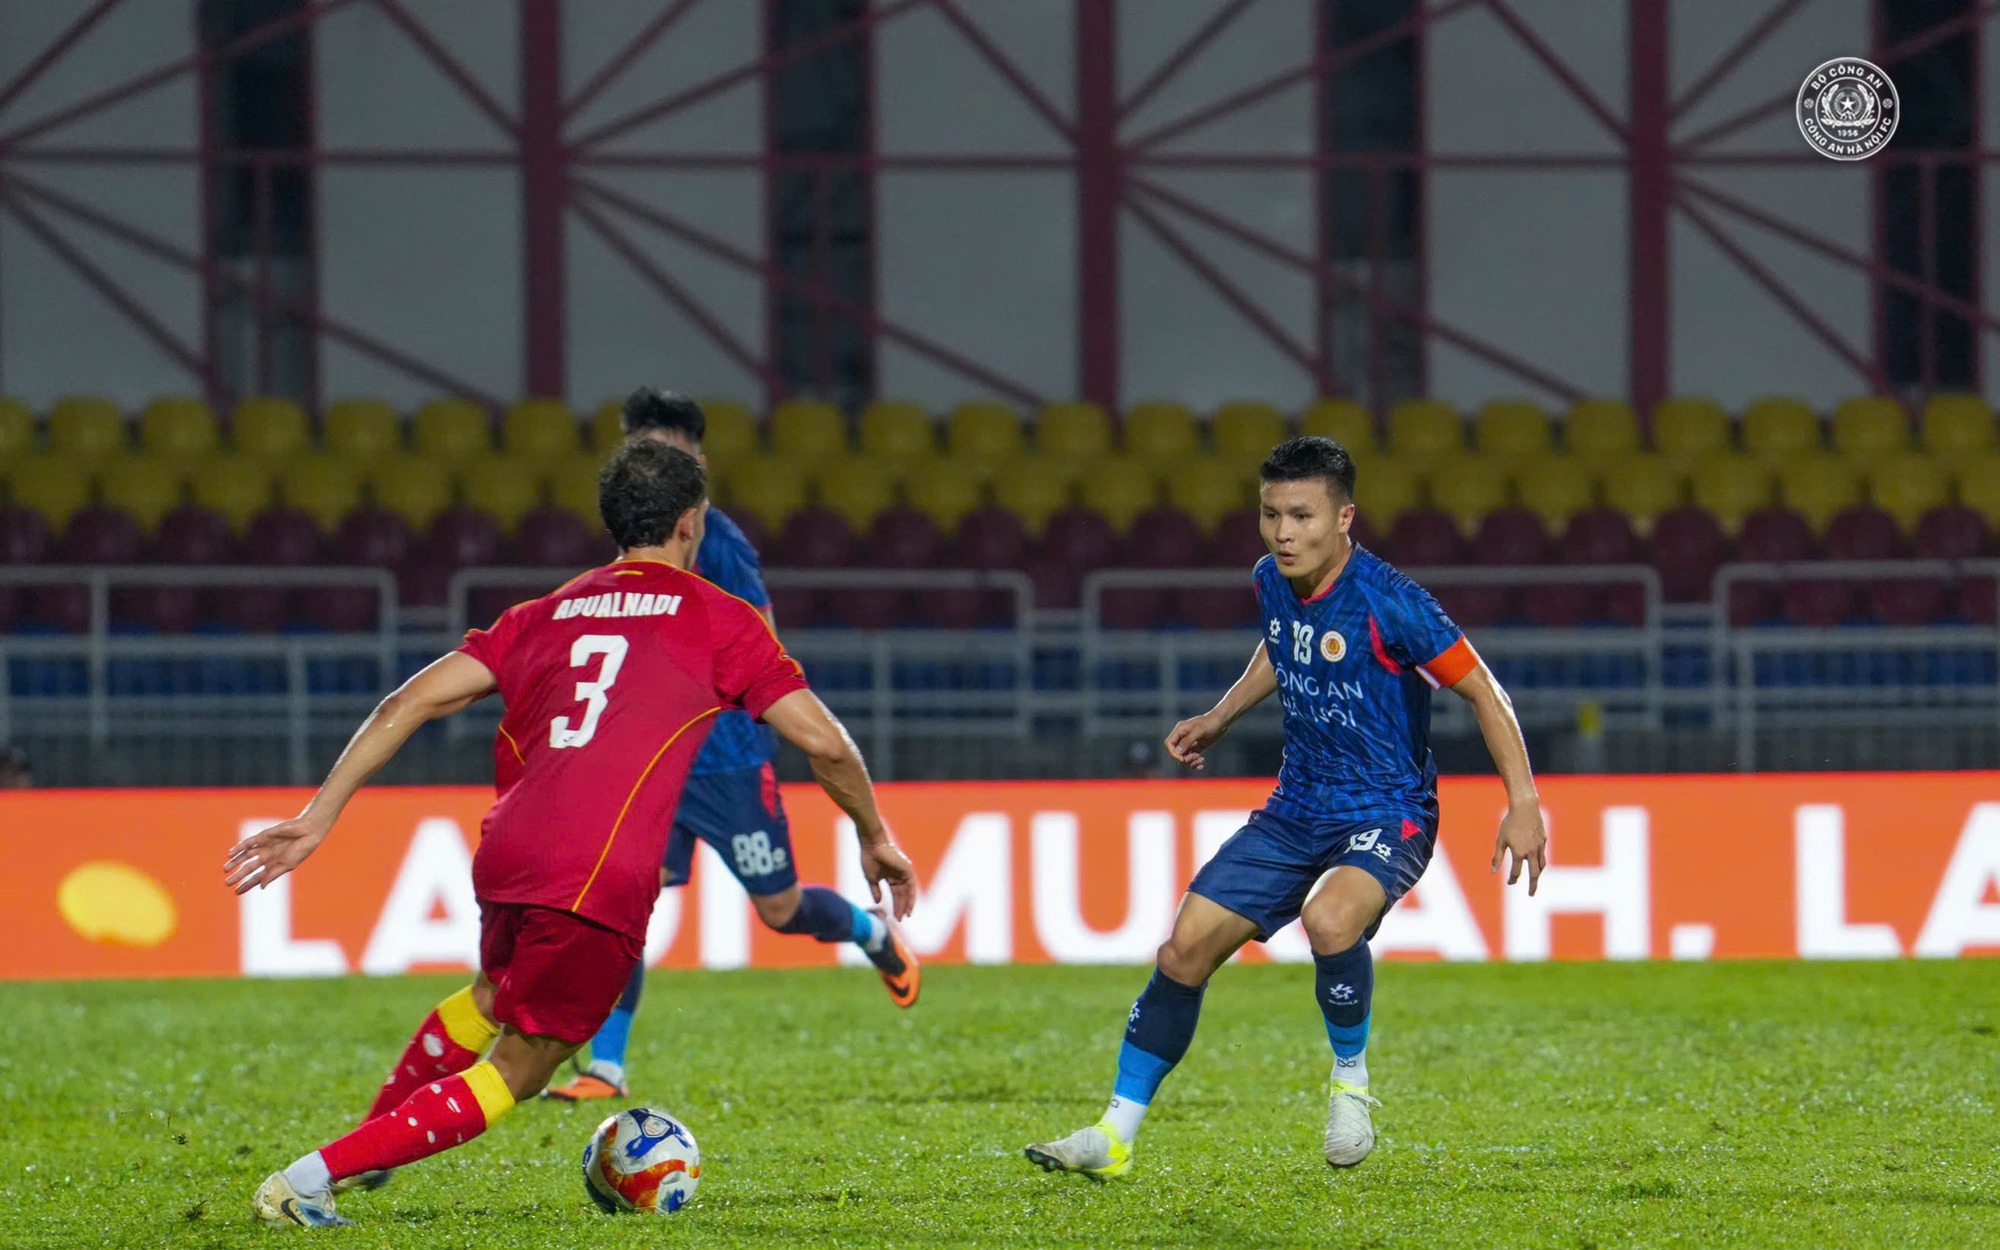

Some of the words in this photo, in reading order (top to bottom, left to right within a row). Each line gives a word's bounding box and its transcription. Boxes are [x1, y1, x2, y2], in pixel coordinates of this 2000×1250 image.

[552, 592, 683, 620] ABUALNADI
[1293, 620, 1314, 665] 19
[549, 634, 629, 749] 3
[1275, 662, 1320, 696] ÔNG
[1327, 681, 1364, 700] AN
[731, 830, 773, 876] 88
[1343, 828, 1382, 854] 19
[239, 815, 749, 976] LAI
